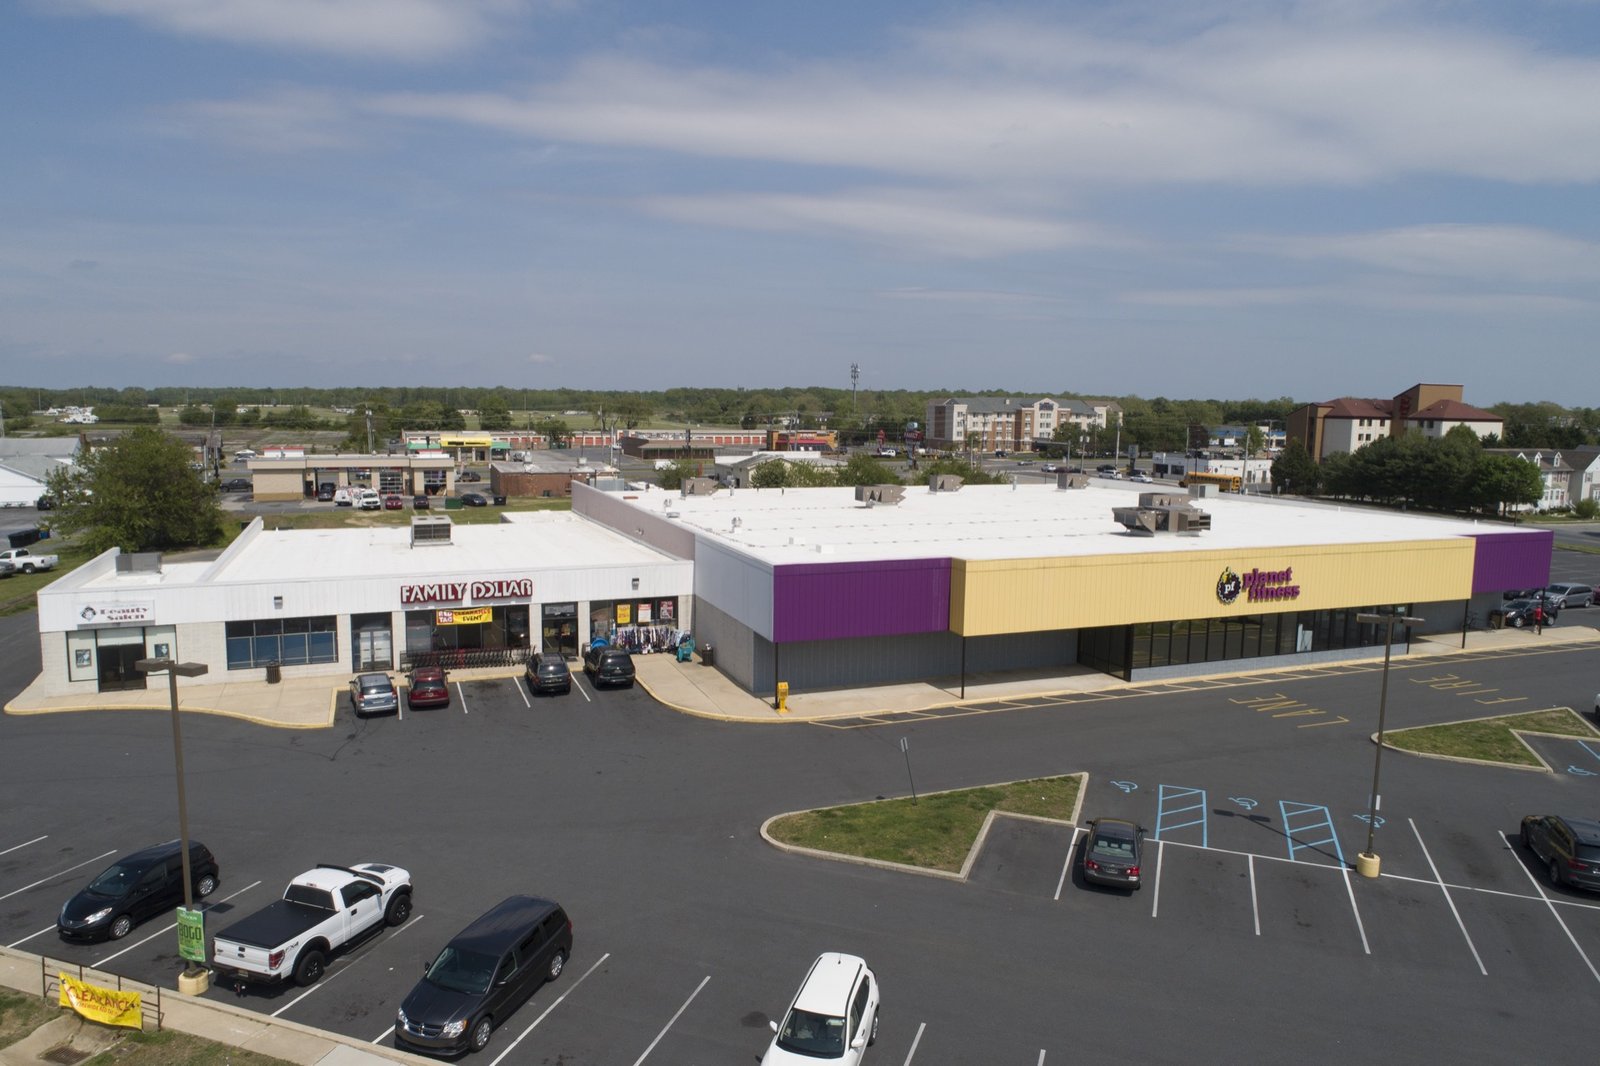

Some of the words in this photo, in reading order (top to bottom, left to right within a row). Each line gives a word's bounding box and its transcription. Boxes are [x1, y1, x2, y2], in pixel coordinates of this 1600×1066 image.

[1224, 581, 1236, 594] pf
[1242, 566, 1293, 591] planet
[401, 583, 467, 603] FAMILY
[471, 579, 532, 600] DOLLAR
[1249, 584, 1300, 602] fitness
[178, 922, 202, 941] BOGO
[67, 985, 130, 1011] CLEARANCE
